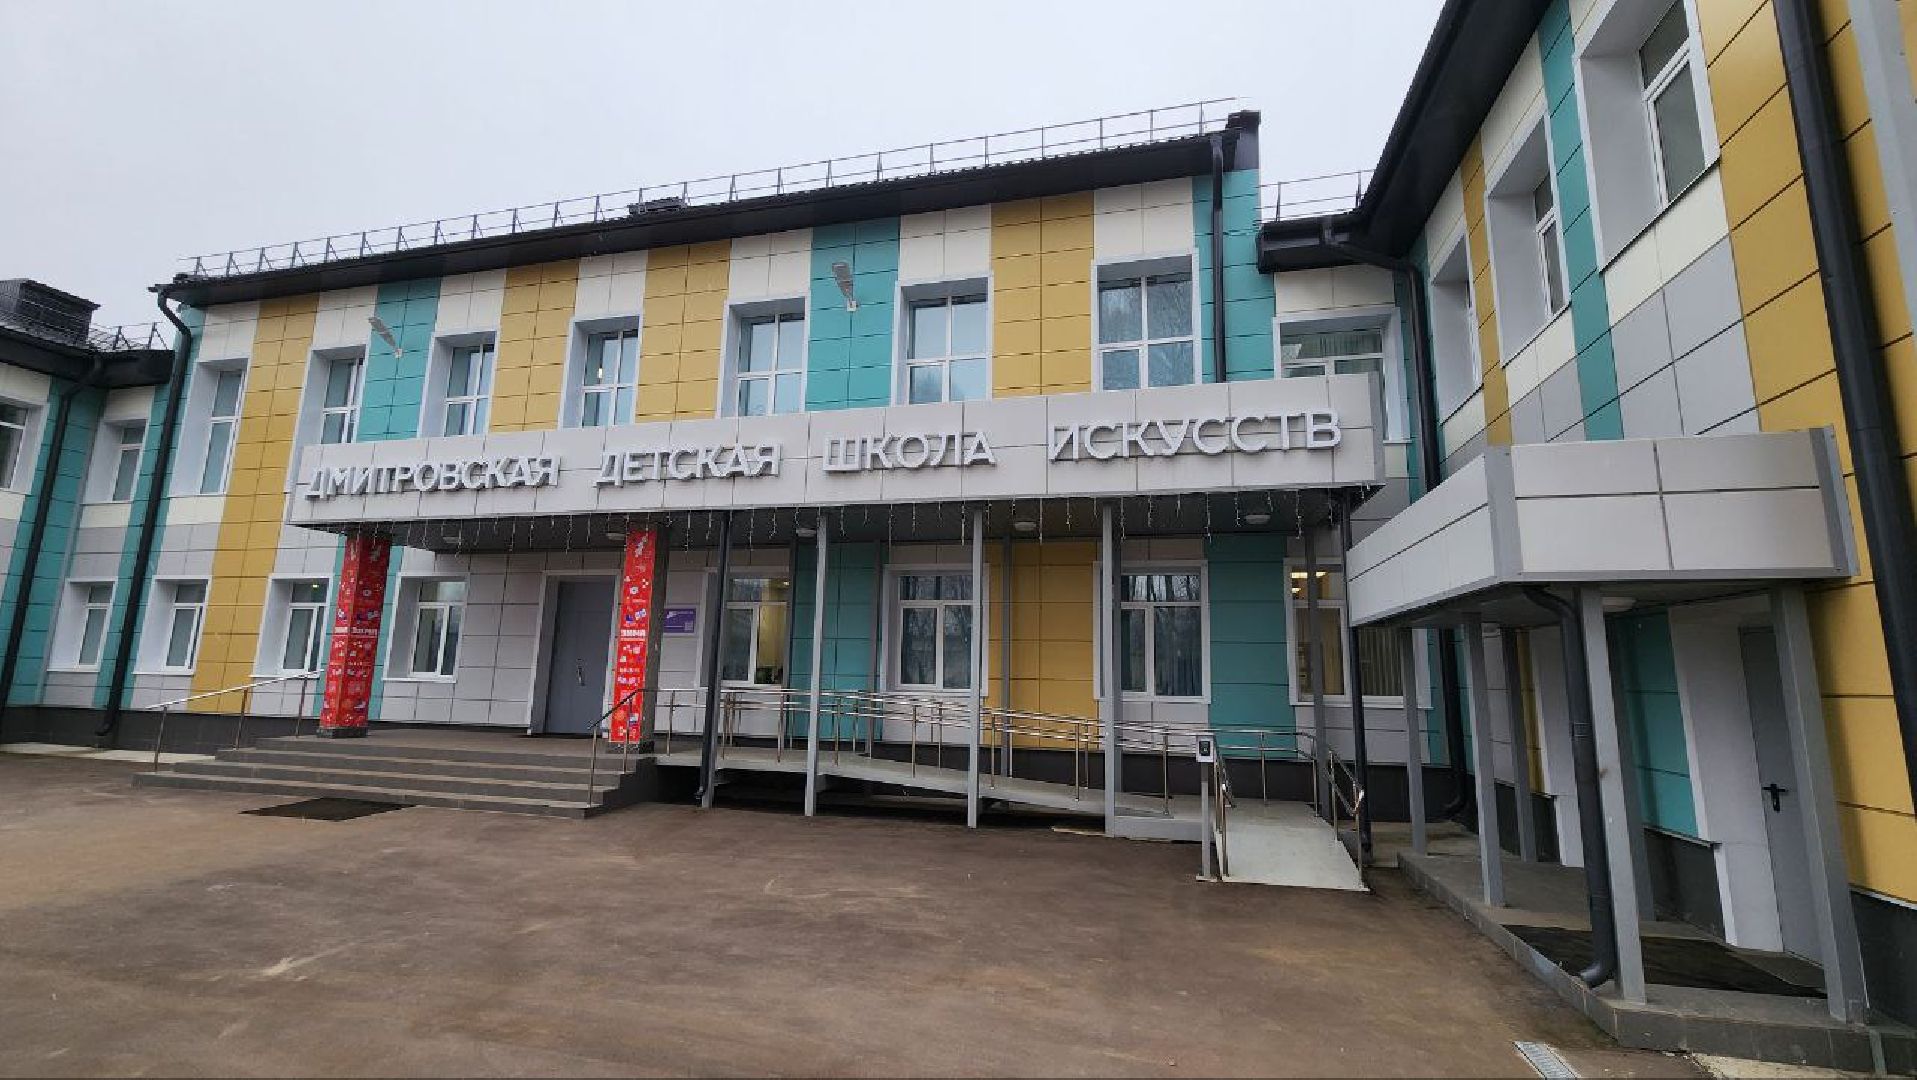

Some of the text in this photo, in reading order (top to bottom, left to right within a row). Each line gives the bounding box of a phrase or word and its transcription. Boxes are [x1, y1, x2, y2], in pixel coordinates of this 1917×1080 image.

[305, 407, 1342, 500] ДМИТРОВСКАЯ ДЕТСКАЯ ШКОЛА ИСКУССТВ
